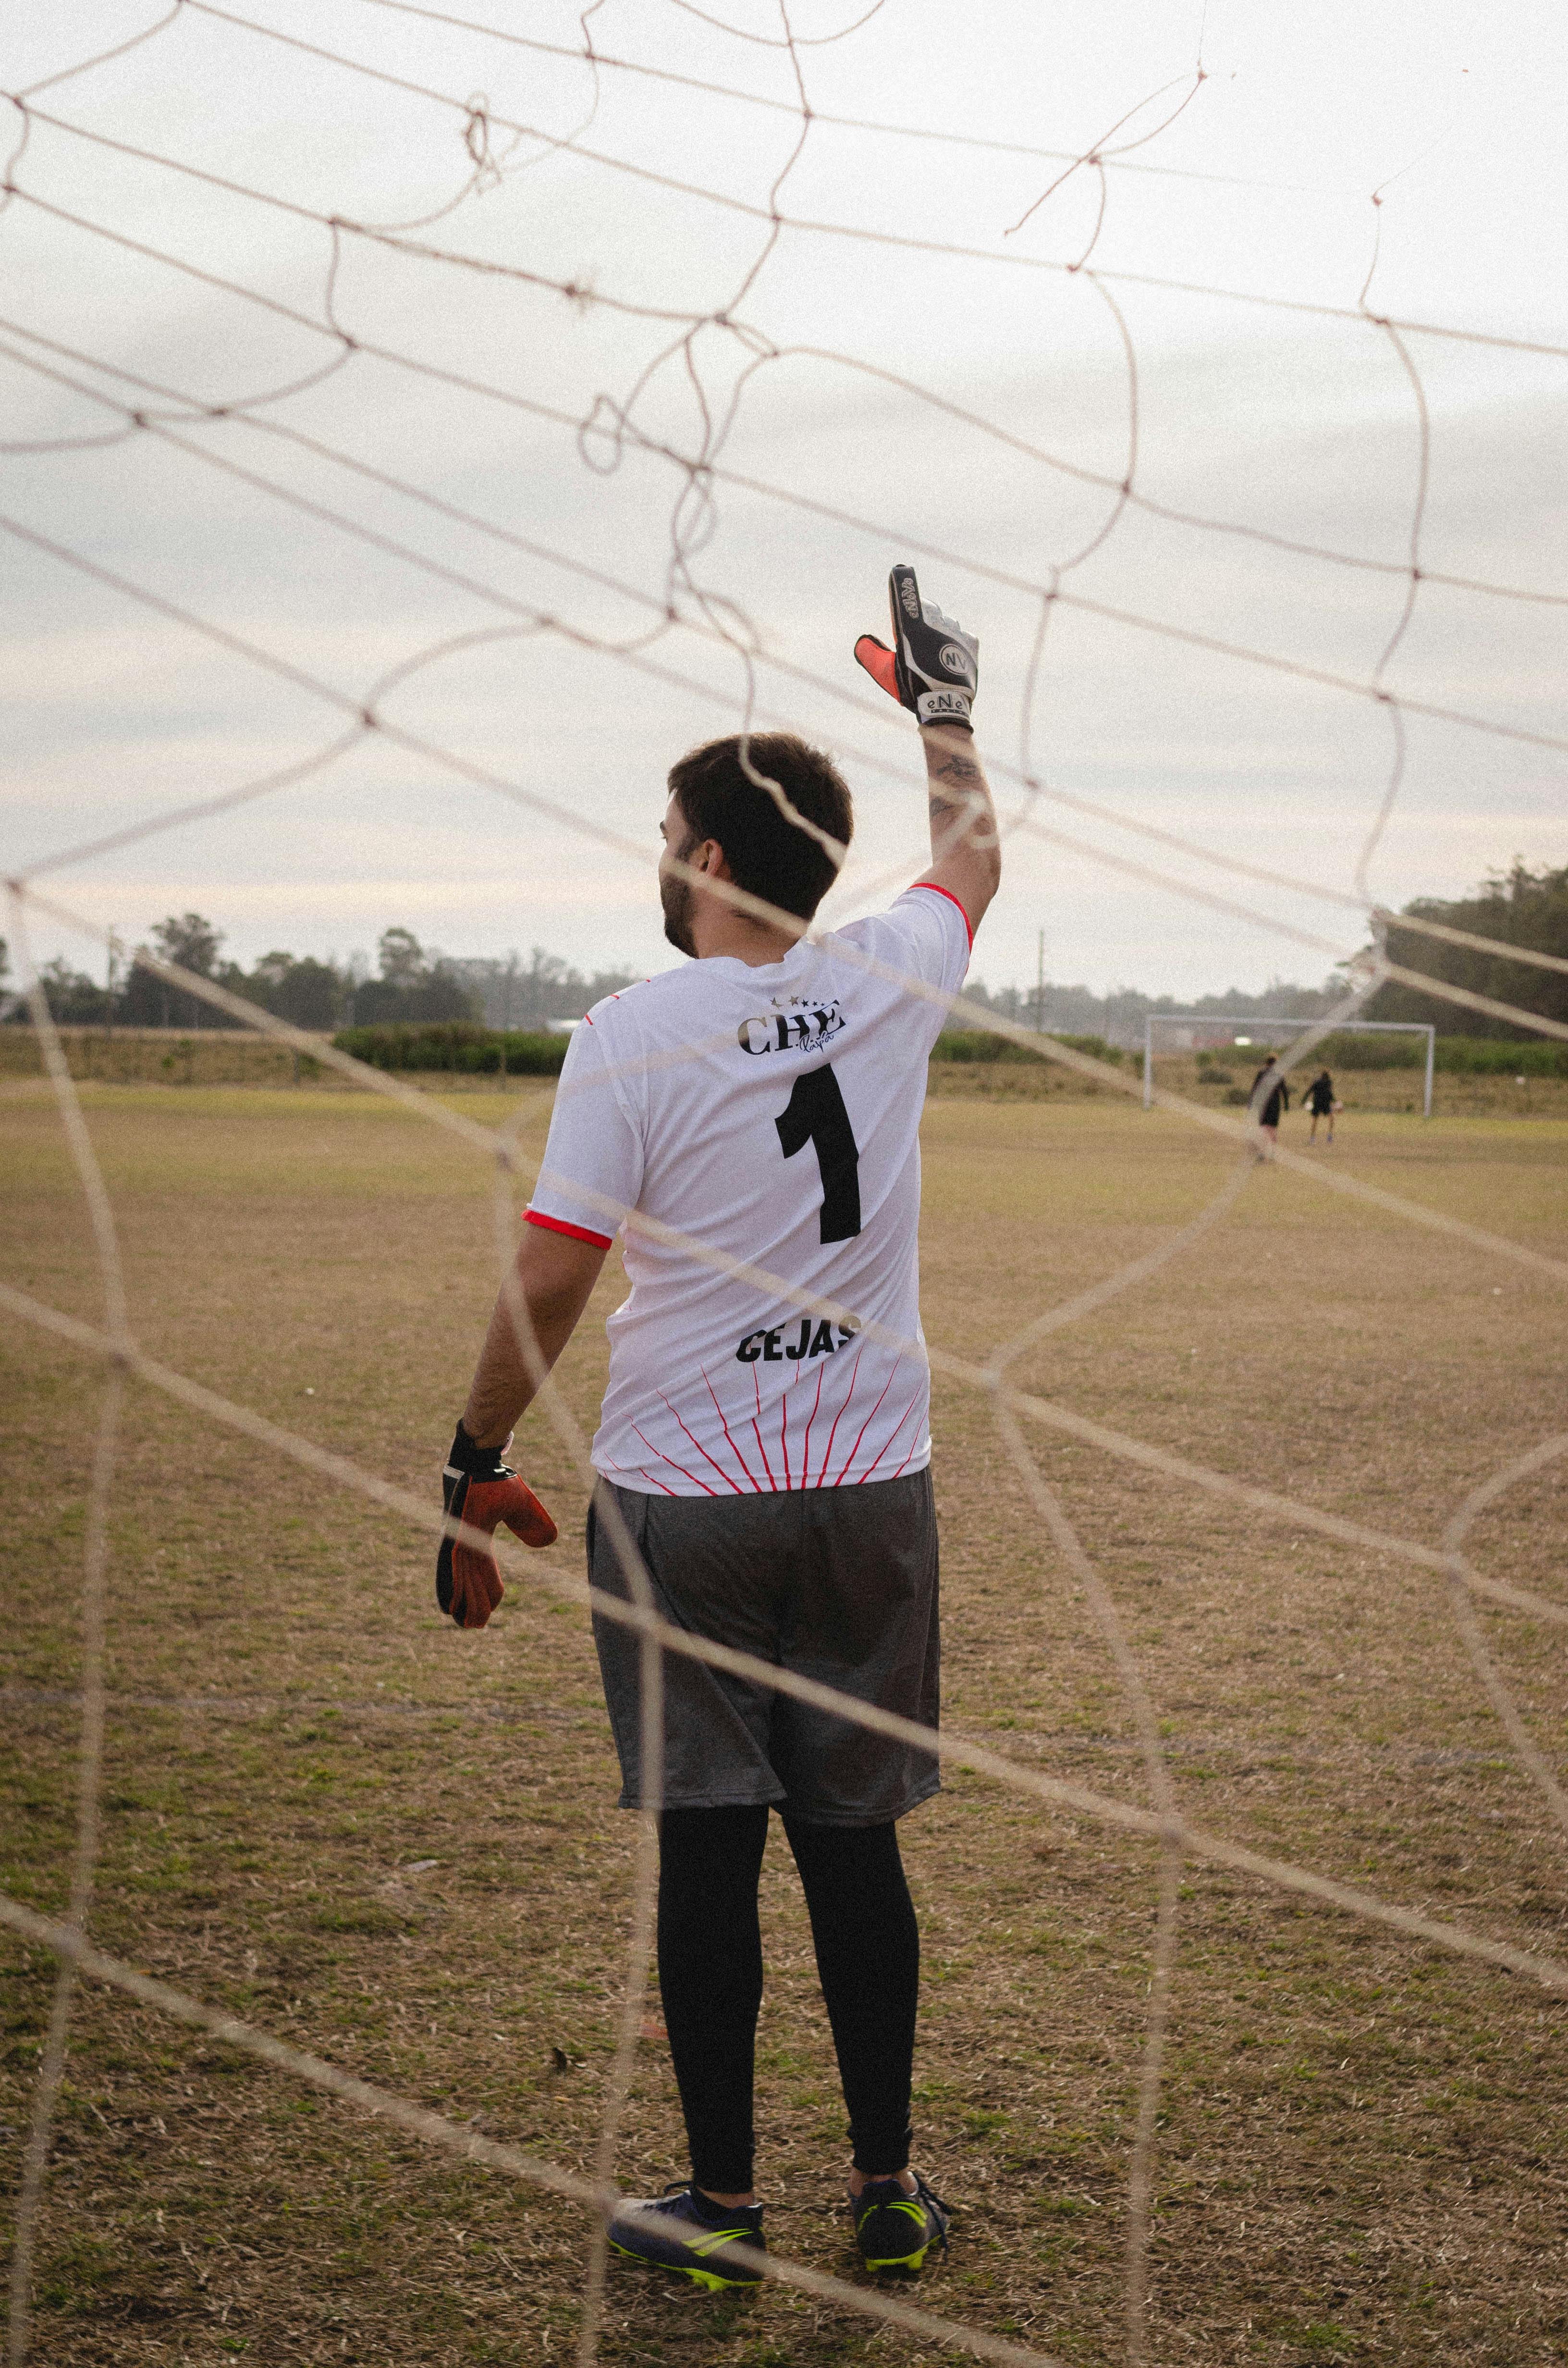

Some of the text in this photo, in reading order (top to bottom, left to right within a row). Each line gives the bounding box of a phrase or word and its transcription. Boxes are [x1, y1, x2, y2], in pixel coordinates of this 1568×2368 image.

[737, 999, 846, 1055] CHE
[775, 1062, 861, 1244] 1
[736, 1315, 861, 1362] CEJAS
